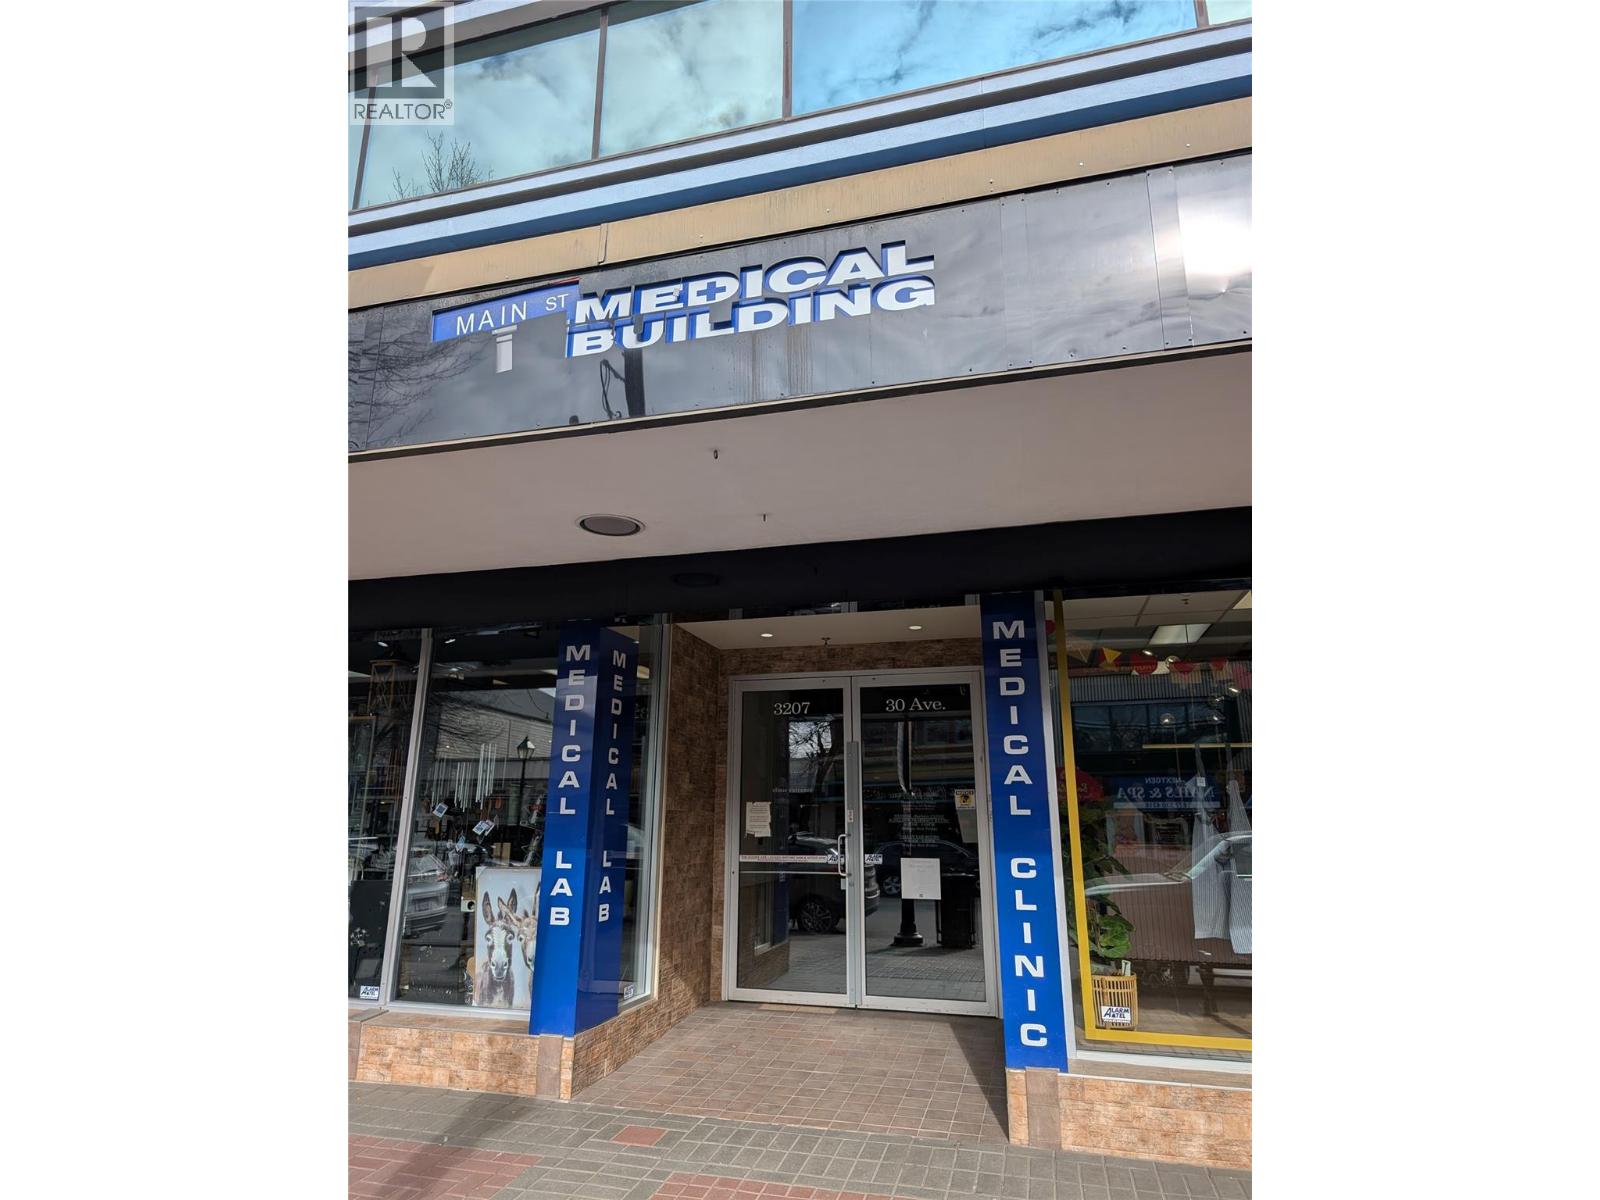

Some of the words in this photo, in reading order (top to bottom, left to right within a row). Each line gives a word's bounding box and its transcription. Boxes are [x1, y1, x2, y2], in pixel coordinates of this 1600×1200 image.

[456, 301, 527, 335] MAIN
[545, 294, 569, 311] ST
[571, 279, 936, 357] BUILDING
[574, 243, 935, 325] MEDICAL
[558, 644, 591, 815] MEDICAL
[605, 649, 627, 816] MEDICAL
[773, 702, 811, 716] 3207
[885, 699, 906, 712] 30
[909, 697, 946, 711] Ave.
[992, 619, 1033, 816] MEDICAL
[549, 850, 573, 926] LAB
[598, 850, 612, 923] LAB
[1011, 857, 1048, 1047] CLINIC
